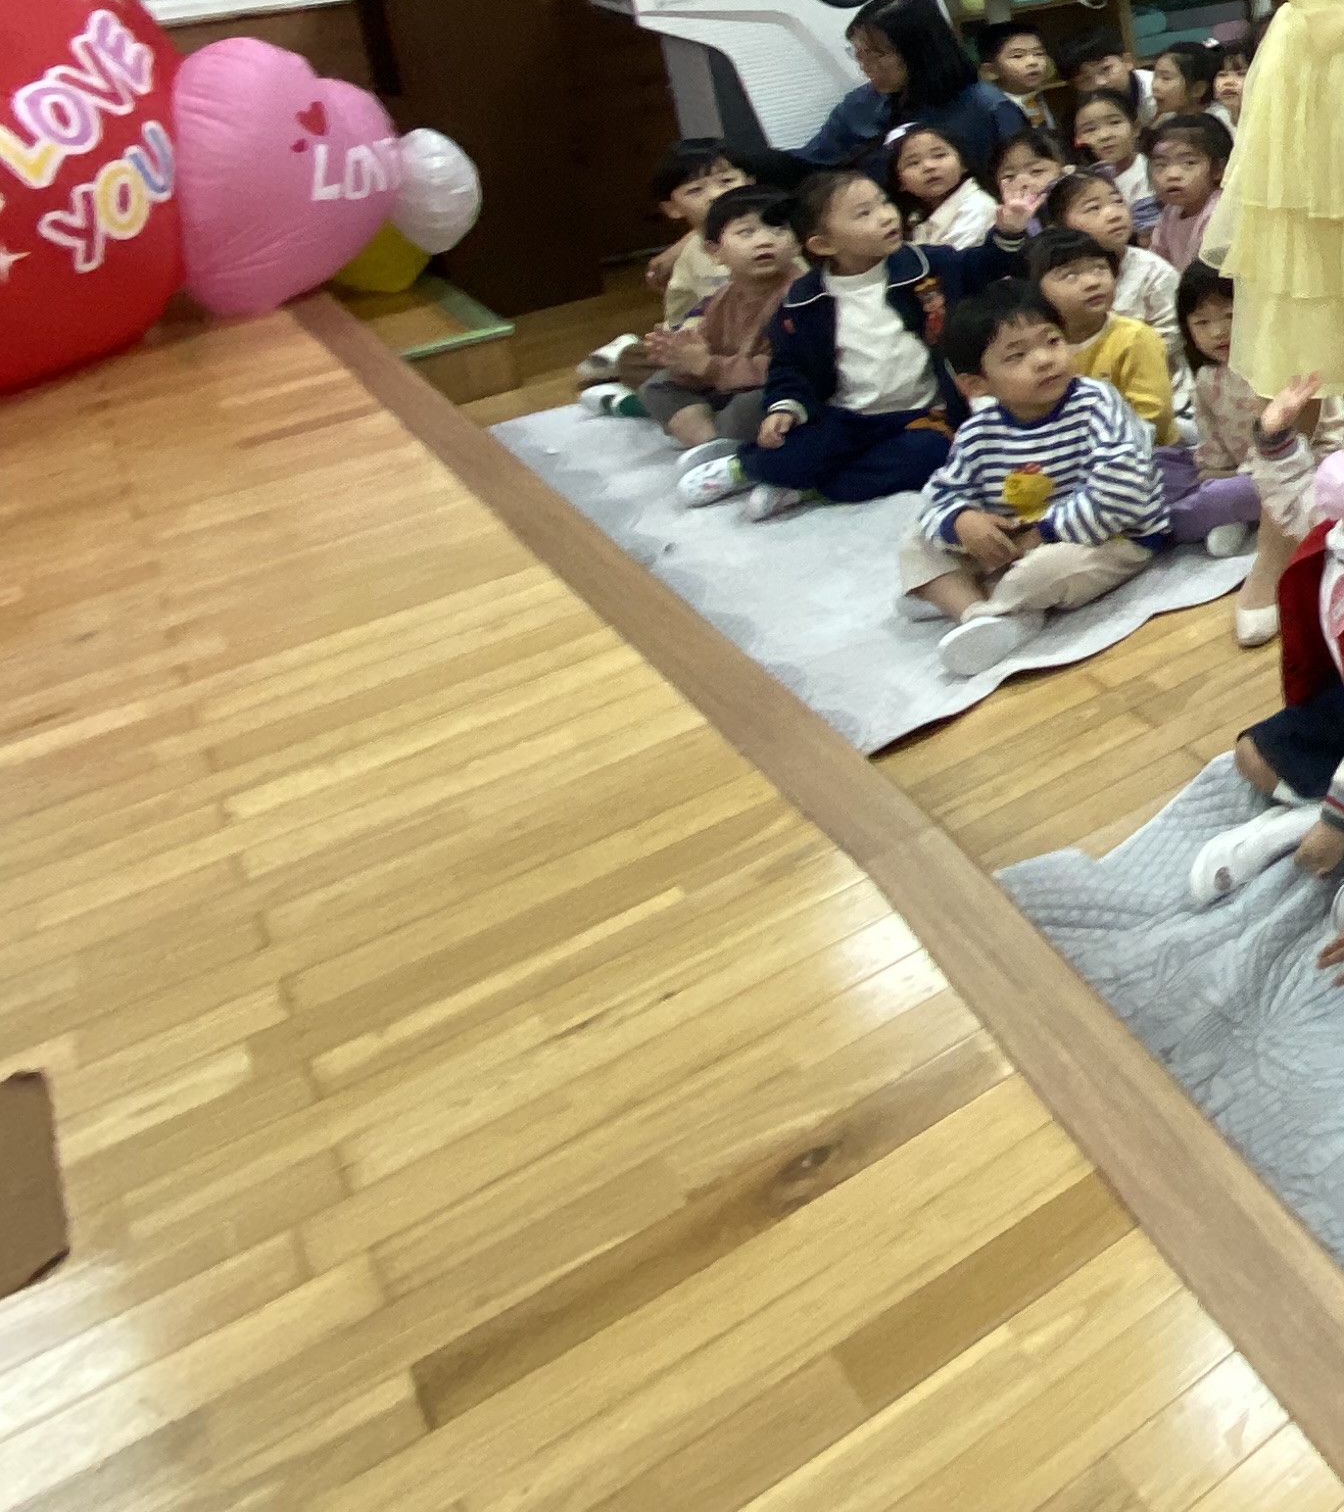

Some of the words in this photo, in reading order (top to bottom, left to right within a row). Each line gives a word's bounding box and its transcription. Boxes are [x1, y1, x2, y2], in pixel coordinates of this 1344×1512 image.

[0, 9, 153, 189] LOVE
[311, 138, 397, 201] LOV
[37, 120, 174, 273] YOU
